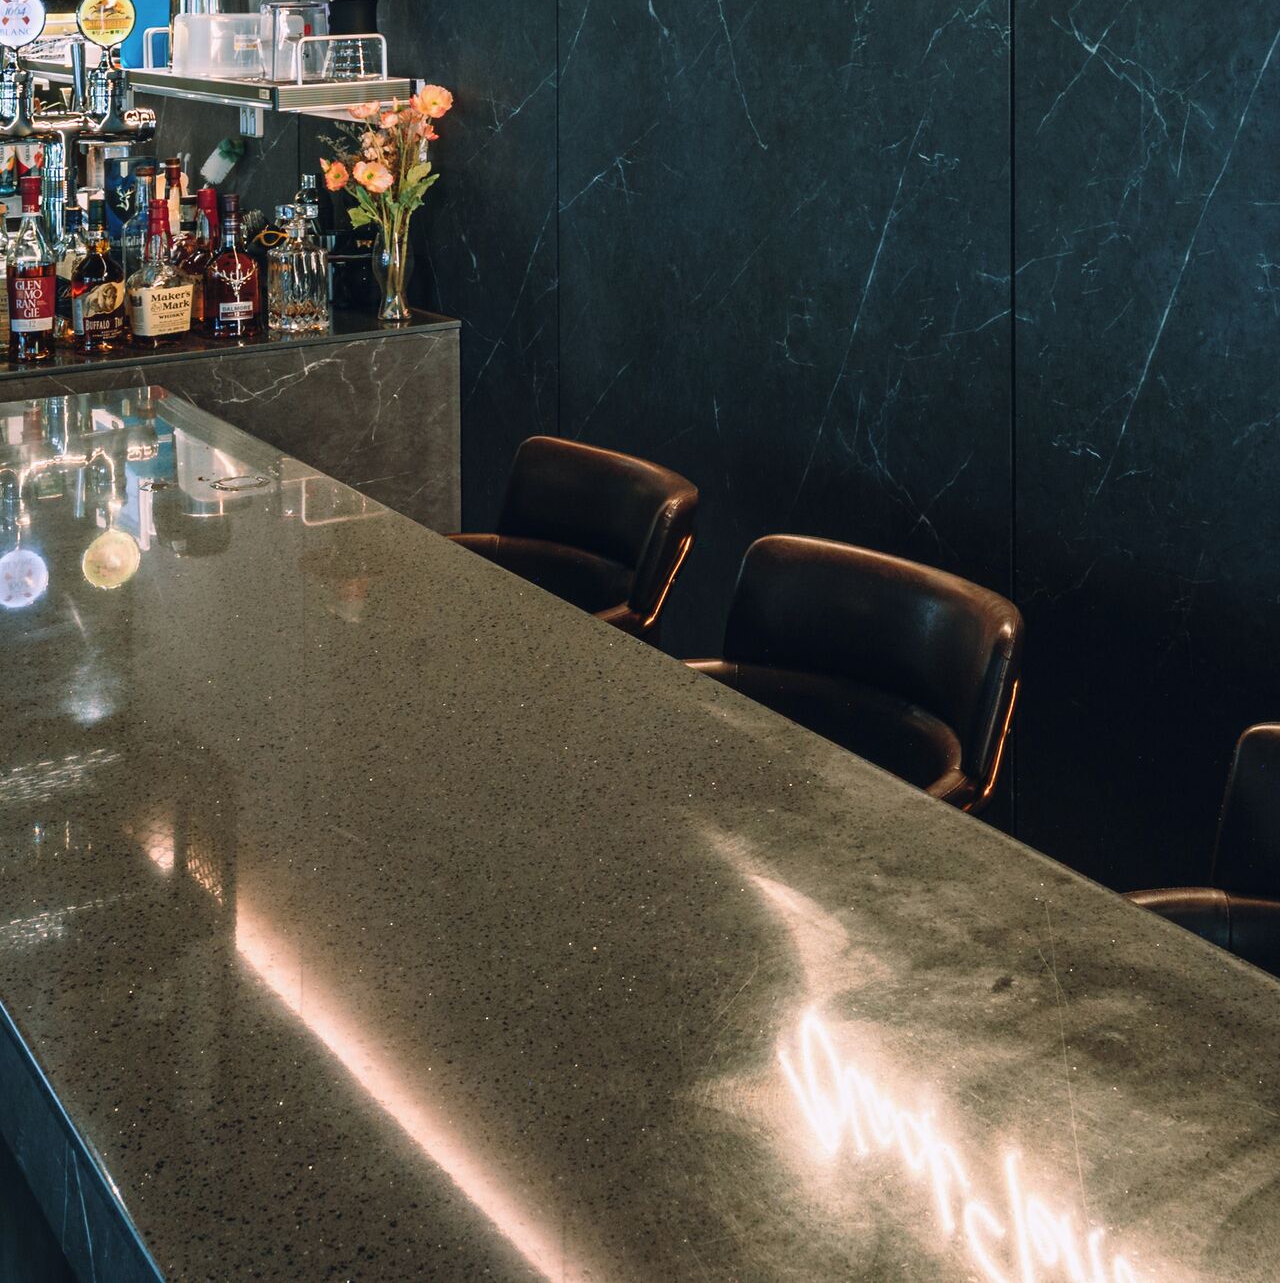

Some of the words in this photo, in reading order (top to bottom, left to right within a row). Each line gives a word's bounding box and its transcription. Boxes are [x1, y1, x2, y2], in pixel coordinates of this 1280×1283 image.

[5, 7, 26, 16] 1664
[0, 28, 32, 36] BLANC
[15, 280, 41, 291] GLEN
[24, 289, 43, 299] MO
[151, 291, 191, 302] Maker's
[16, 299, 36, 309] RAN
[162, 300, 190, 311] Mark
[222, 304, 251, 312] DALMORE
[23, 308, 41, 319] GIE
[159, 311, 185, 319] WHISKY
[85, 319, 111, 330] BUFFALO
